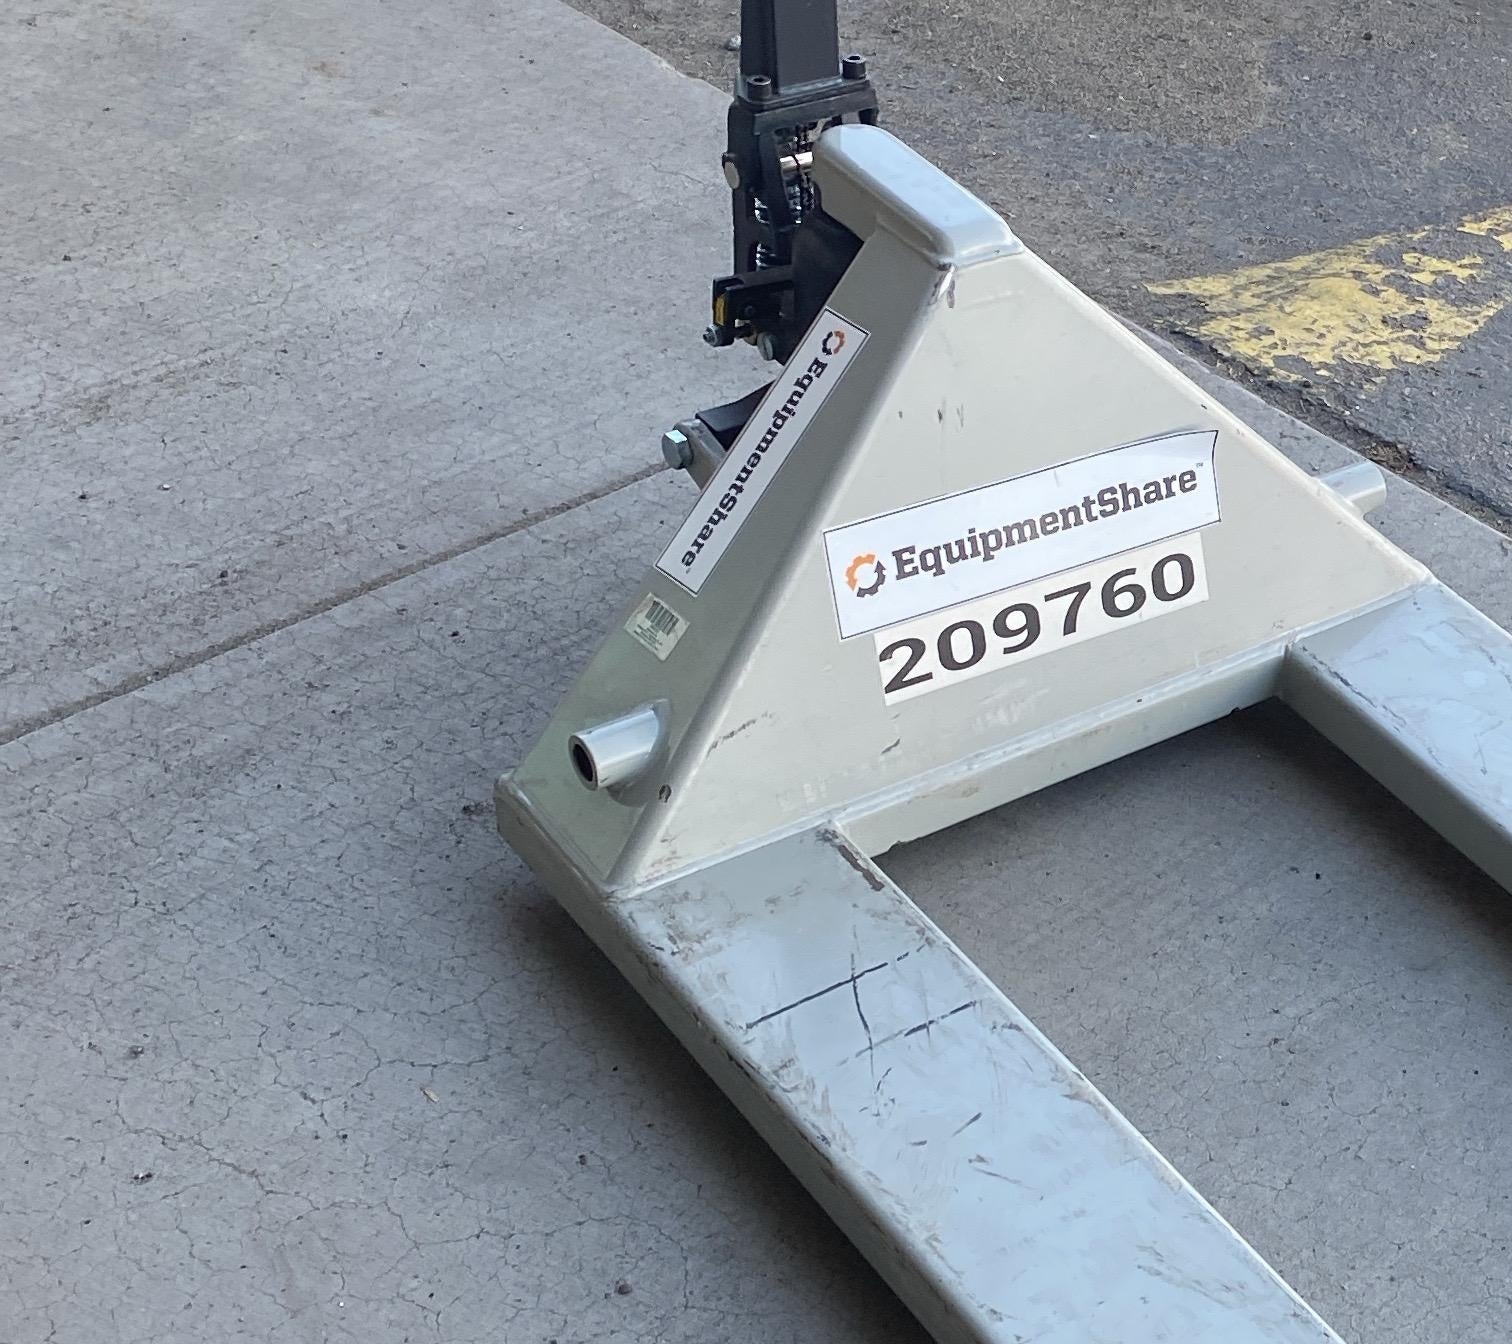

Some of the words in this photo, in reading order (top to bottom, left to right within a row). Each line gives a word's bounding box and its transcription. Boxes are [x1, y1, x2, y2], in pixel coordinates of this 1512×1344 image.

[681, 357, 828, 568] EquipmentShare
[892, 469, 1198, 579] EquipmentShare
[878, 552, 1196, 694] 209760
